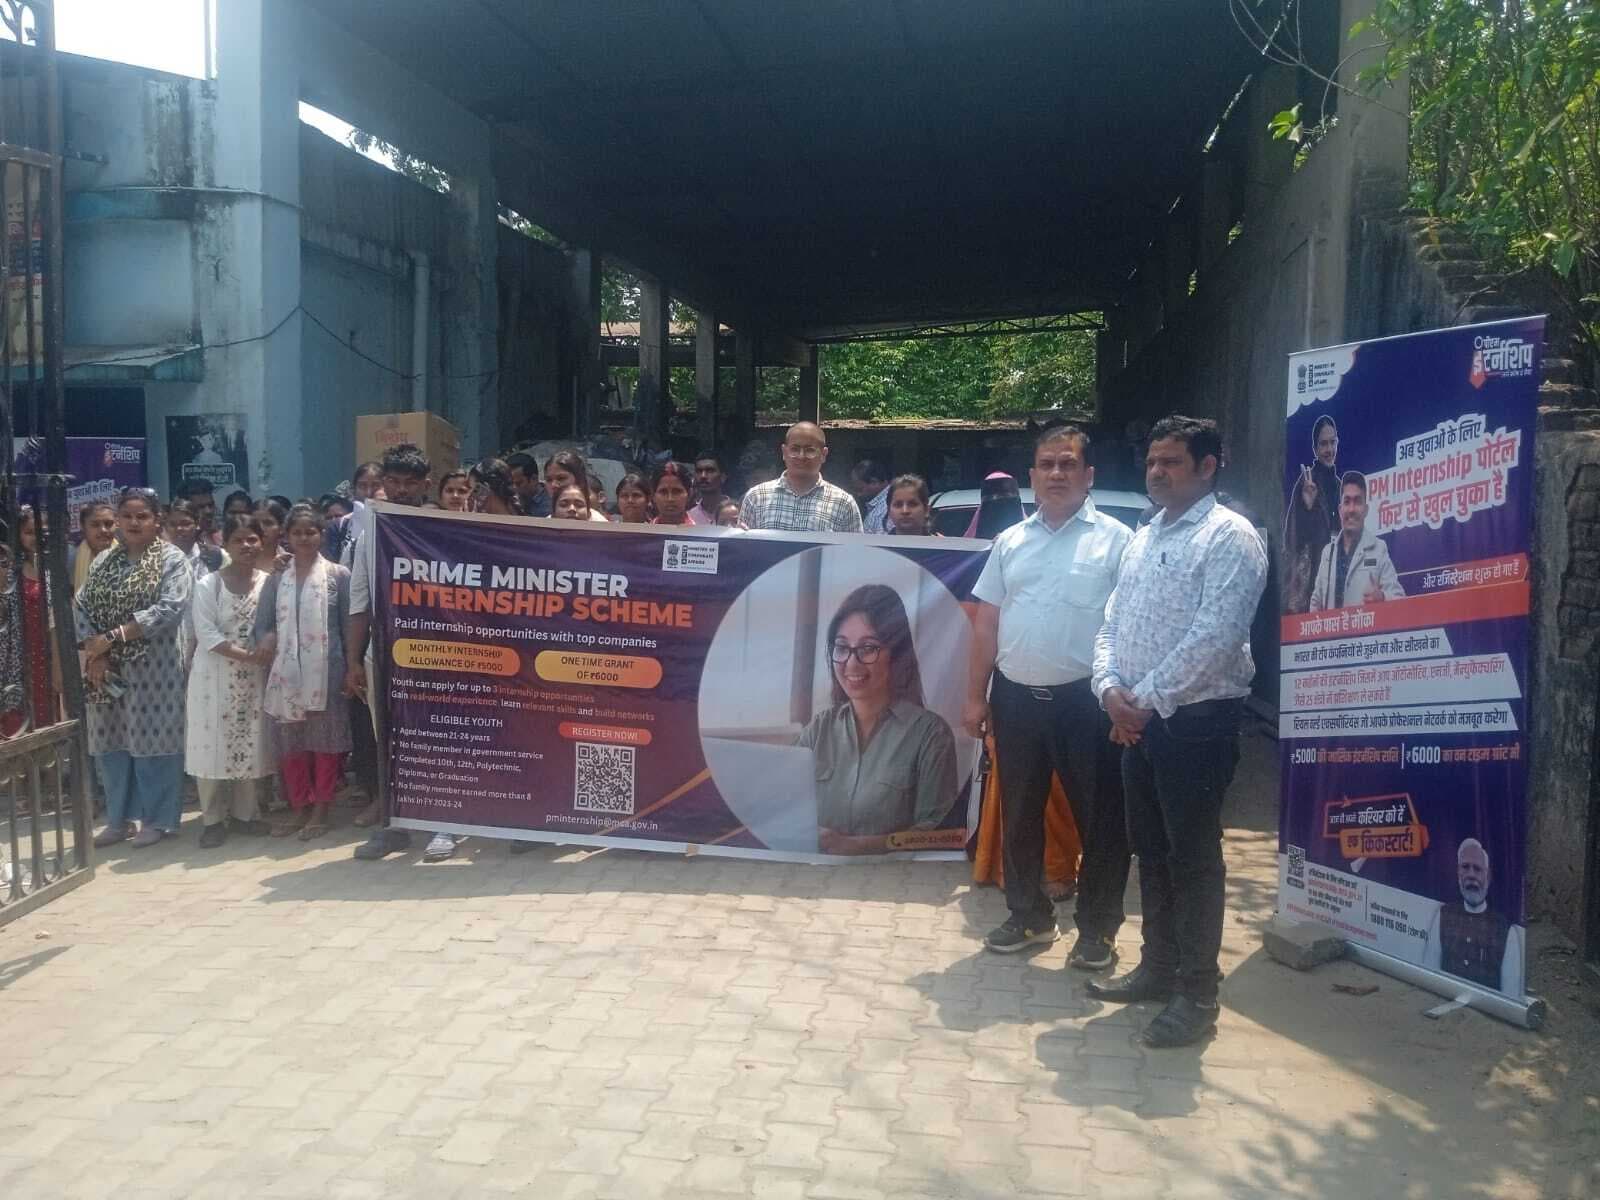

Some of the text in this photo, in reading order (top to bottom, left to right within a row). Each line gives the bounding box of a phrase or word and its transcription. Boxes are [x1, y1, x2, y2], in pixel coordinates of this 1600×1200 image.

[1399, 419, 1482, 461] अब युवाओं के लिए
[1368, 434, 1518, 499] PM Internship पोर्टल
[1378, 468, 1504, 530] फिर से खुल चुका है
[393, 557, 629, 598] PRIME MINISTER
[1422, 573, 1436, 589] और
[1437, 567, 1473, 587] रजिस्ट्रेशन
[1492, 561, 1502, 579] हो
[391, 581, 693, 628] INTERNSHIP SCHEME
[394, 617, 657, 649] Paid internship opportunities with top companies
[1300, 615, 1323, 636] आपके
[1323, 617, 1341, 633] पास
[1342, 611, 1350, 631] है
[409, 643, 503, 659] MONTHLY INTERNSHIP
[1328, 642, 1355, 660] कंपनियों
[1355, 642, 1363, 656] से
[1379, 643, 1389, 656] का
[1390, 638, 1403, 654] और
[1430, 637, 1440, 649] का
[408, 656, 464, 668] ALLOWANCE
[464, 661, 477, 669] OF
[560, 656, 635, 669] ONE TIME GRANT
[576, 670, 619, 681] OF ₹6000
[391, 677, 595, 703] Youth can apply for up to 3 internship opportunities
[391, 690, 409, 700] Gain
[409, 691, 452, 704] real-world
[501, 699, 521, 709] learn
[521, 702, 555, 713] relevant
[556, 704, 576, 714] skills
[577, 707, 594, 716] and
[594, 708, 616, 718] build
[617, 710, 655, 721] networks
[430, 714, 504, 728] ELIGIBLE YOUTH
[1360, 713, 1369, 729] जो
[1369, 712, 1388, 729] आपके
[1447, 709, 1457, 726] को
[1483, 707, 1508, 725] करेगा
[399, 727, 491, 743] Aged between 21-24 years
[571, 726, 638, 742] REGISTER NOW!
[399, 740, 544, 760] No family member in government service
[399, 753, 436, 766] Completed
[437, 757, 455, 769] 10th,
[457, 760, 475, 770] 12th,
[398, 767, 479, 784] Diploma, or Graduation
[398, 781, 408, 791] No
[409, 782, 431, 794] family
[431, 785, 461, 796] member
[461, 788, 487, 798] earned
[488, 790, 507, 800] more
[508, 791, 525, 801] than
[416, 796, 423, 806] in
[424, 797, 433, 807] FY
[1358, 806, 1385, 825] करियर
[1385, 804, 1397, 823] को
[1397, 804, 1406, 823] दें
